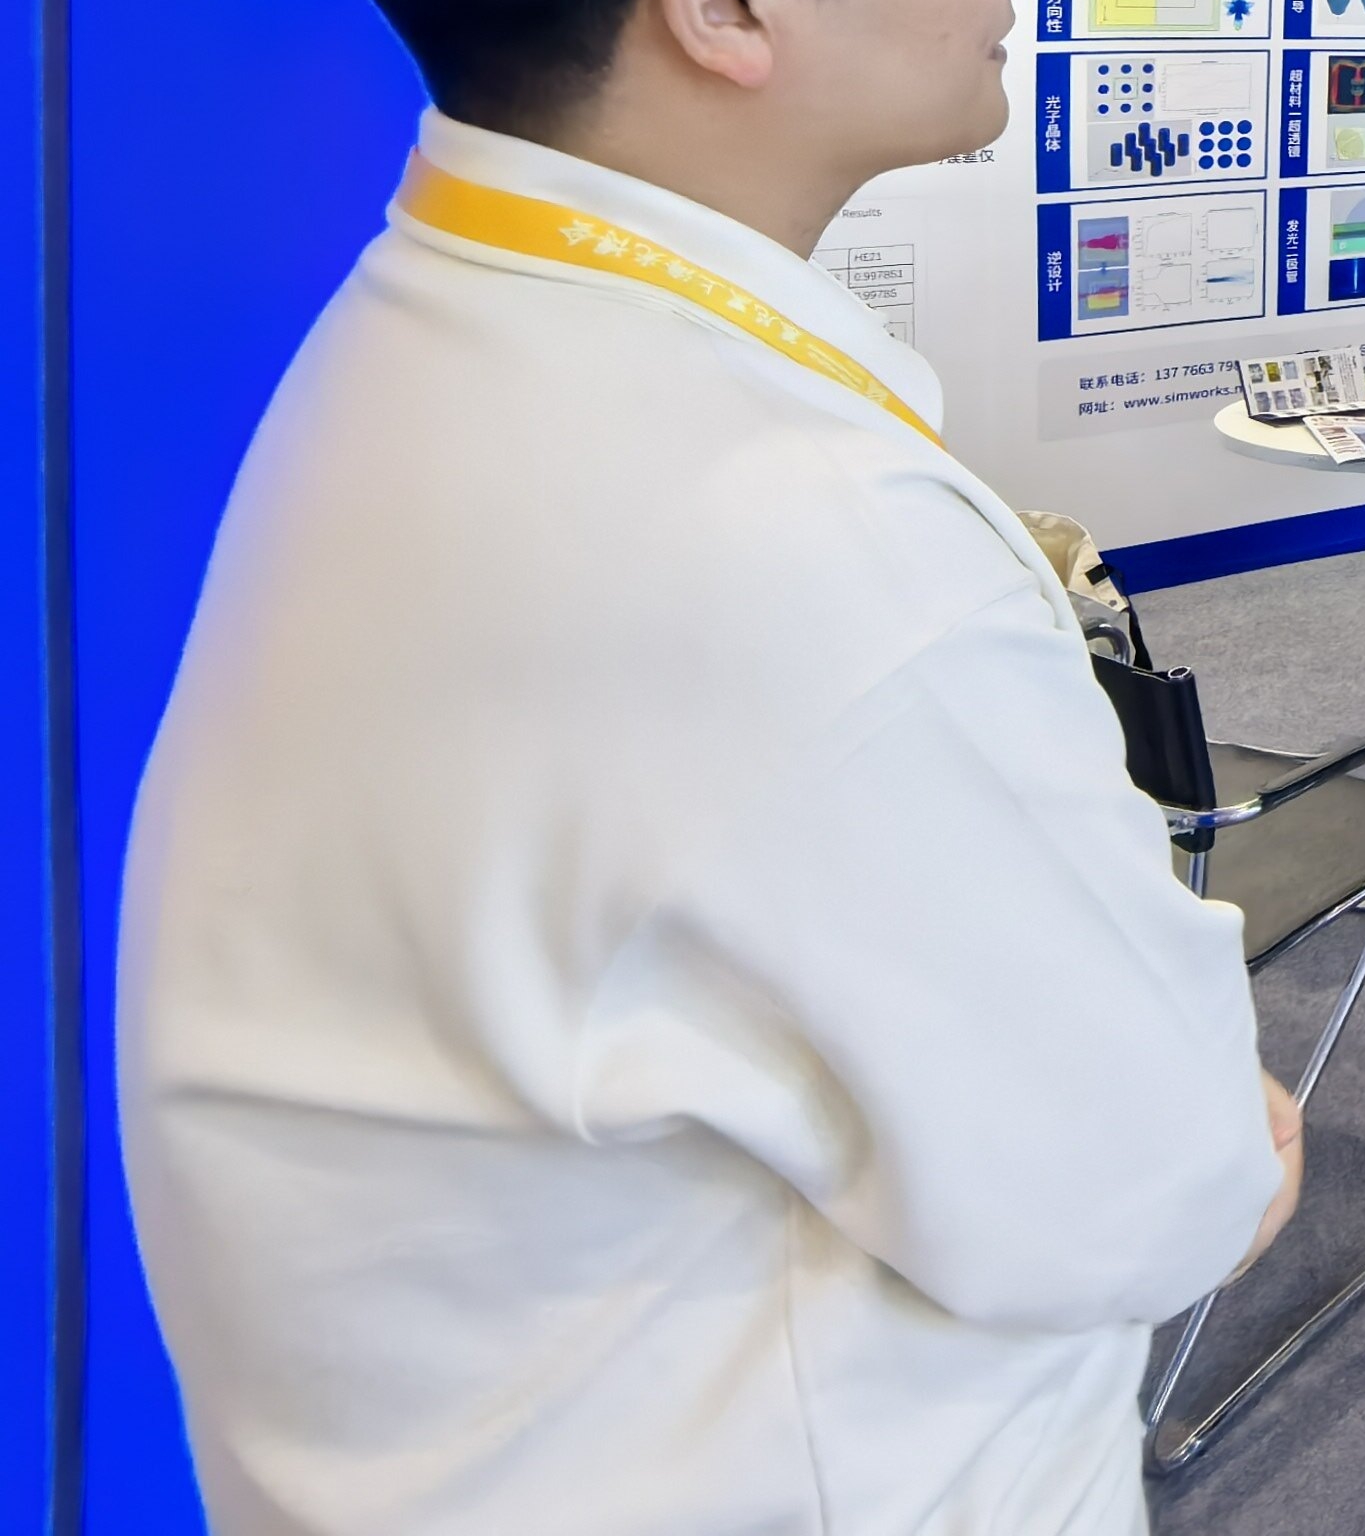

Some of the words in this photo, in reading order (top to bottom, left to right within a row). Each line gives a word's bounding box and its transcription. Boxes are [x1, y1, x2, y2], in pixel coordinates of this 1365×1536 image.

[1044, 95, 1062, 153] 光子晶体
[1046, 250, 1063, 292] 逆设计
[1155, 366, 1178, 381] 137
[1182, 363, 1215, 377] 7663
